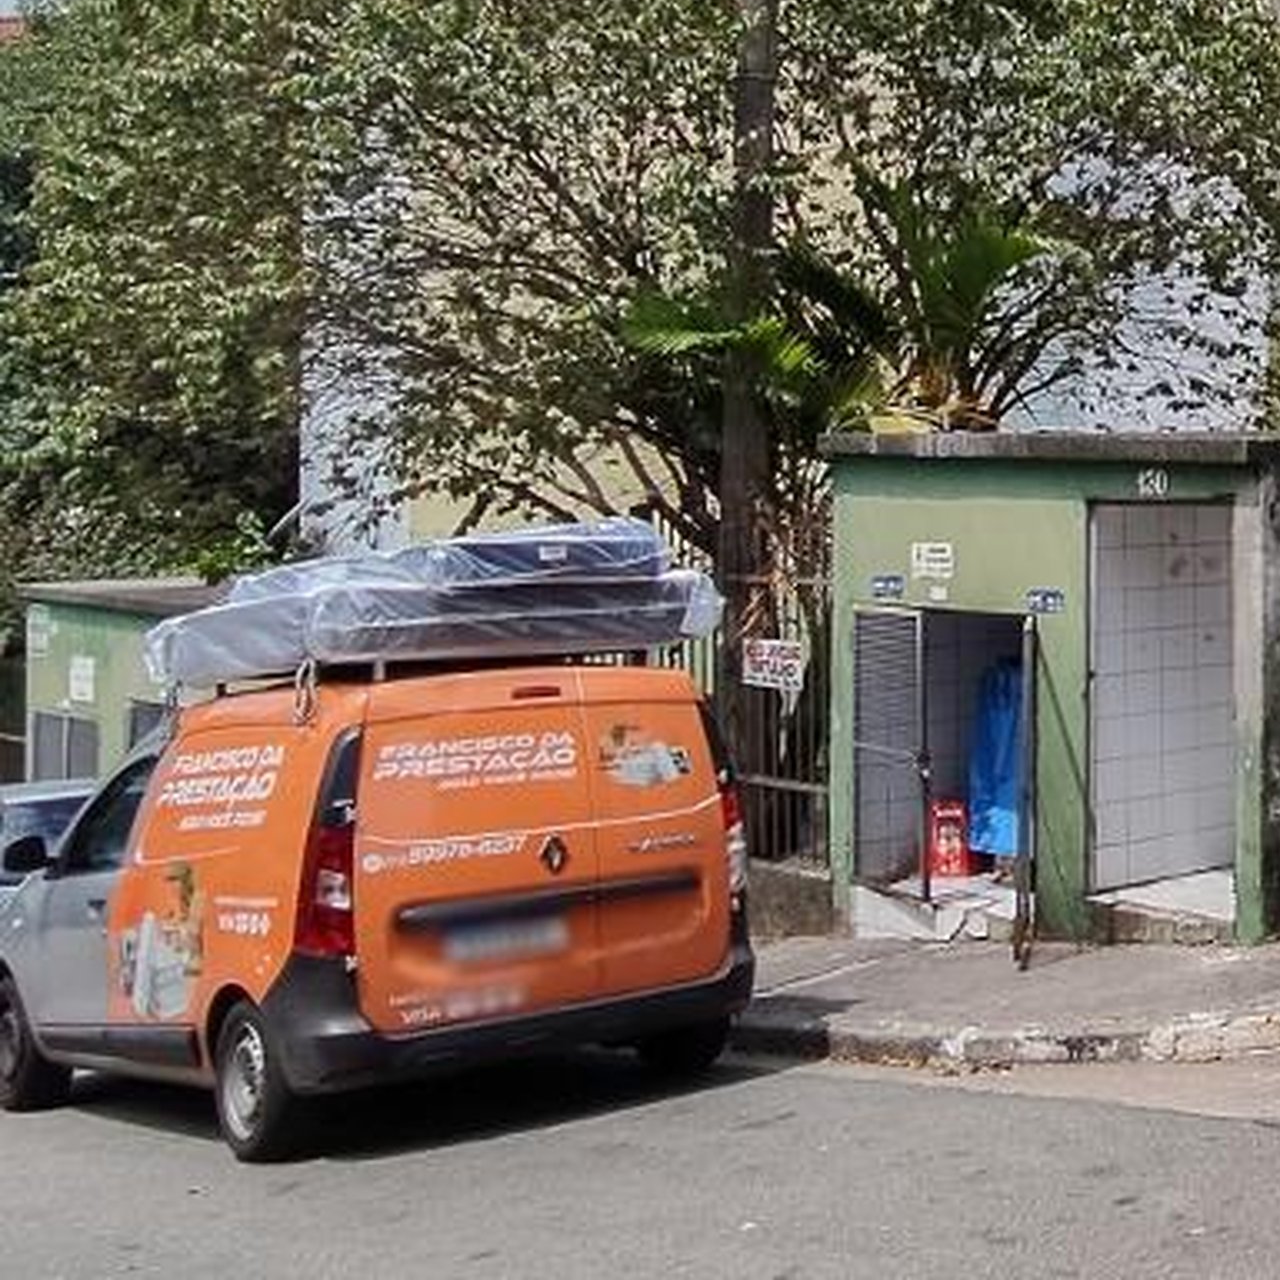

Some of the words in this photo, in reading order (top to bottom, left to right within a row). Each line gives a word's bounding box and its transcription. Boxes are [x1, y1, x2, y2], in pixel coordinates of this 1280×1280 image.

[378, 736, 536, 761] FRANCISCO
[539, 731, 575, 748] DA
[372, 747, 578, 781] PRESTAÇÃO
